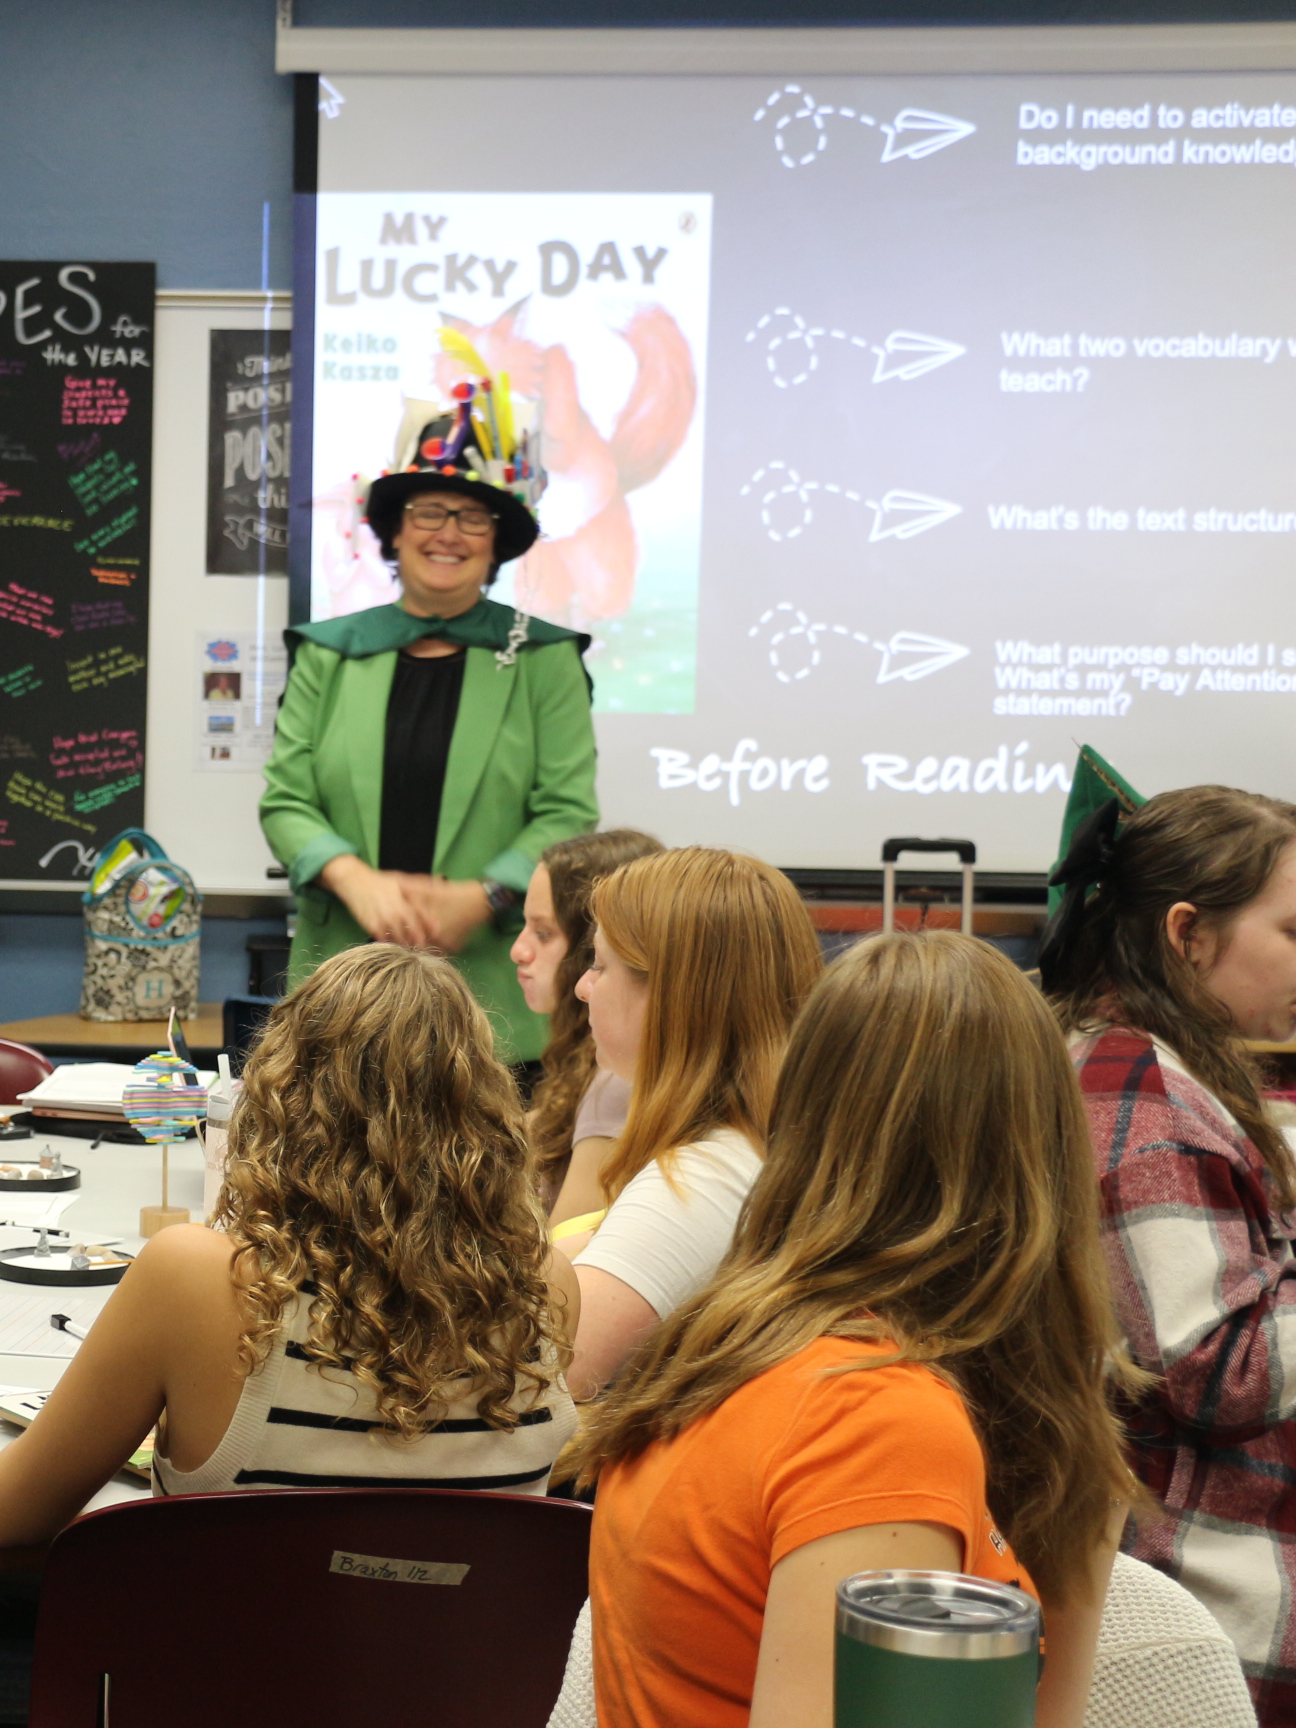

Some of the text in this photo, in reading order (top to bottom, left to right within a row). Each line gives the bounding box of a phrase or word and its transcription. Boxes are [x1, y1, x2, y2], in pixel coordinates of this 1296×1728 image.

[1019, 102, 1296, 130] Do I need to activate
[1016, 138, 1296, 171] background knowled
[378, 211, 449, 246] MY
[110, 314, 149, 339] for
[42, 343, 150, 368] the YEAR
[322, 331, 398, 355] Keiko
[1000, 331, 1072, 357] What
[1078, 332, 1126, 357] two
[1133, 331, 1282, 363] vocabulary
[322, 361, 399, 382] Kasza
[999, 366, 1090, 392] teach?
[226, 381, 292, 414] POSI
[224, 421, 291, 489] POSI
[988, 504, 1296, 532] What's the text structur
[995, 639, 1062, 665] What
[1067, 644, 1170, 669] purpose
[1175, 641, 1260, 666] should
[1266, 643, 1275, 665] I
[994, 666, 1081, 690] What's
[1085, 670, 1126, 697] my
[993, 691, 1132, 716] statement?
[649, 737, 1072, 807] Before Readin
[144, 980, 164, 999] H
[339, 1556, 398, 1581] Braxton
